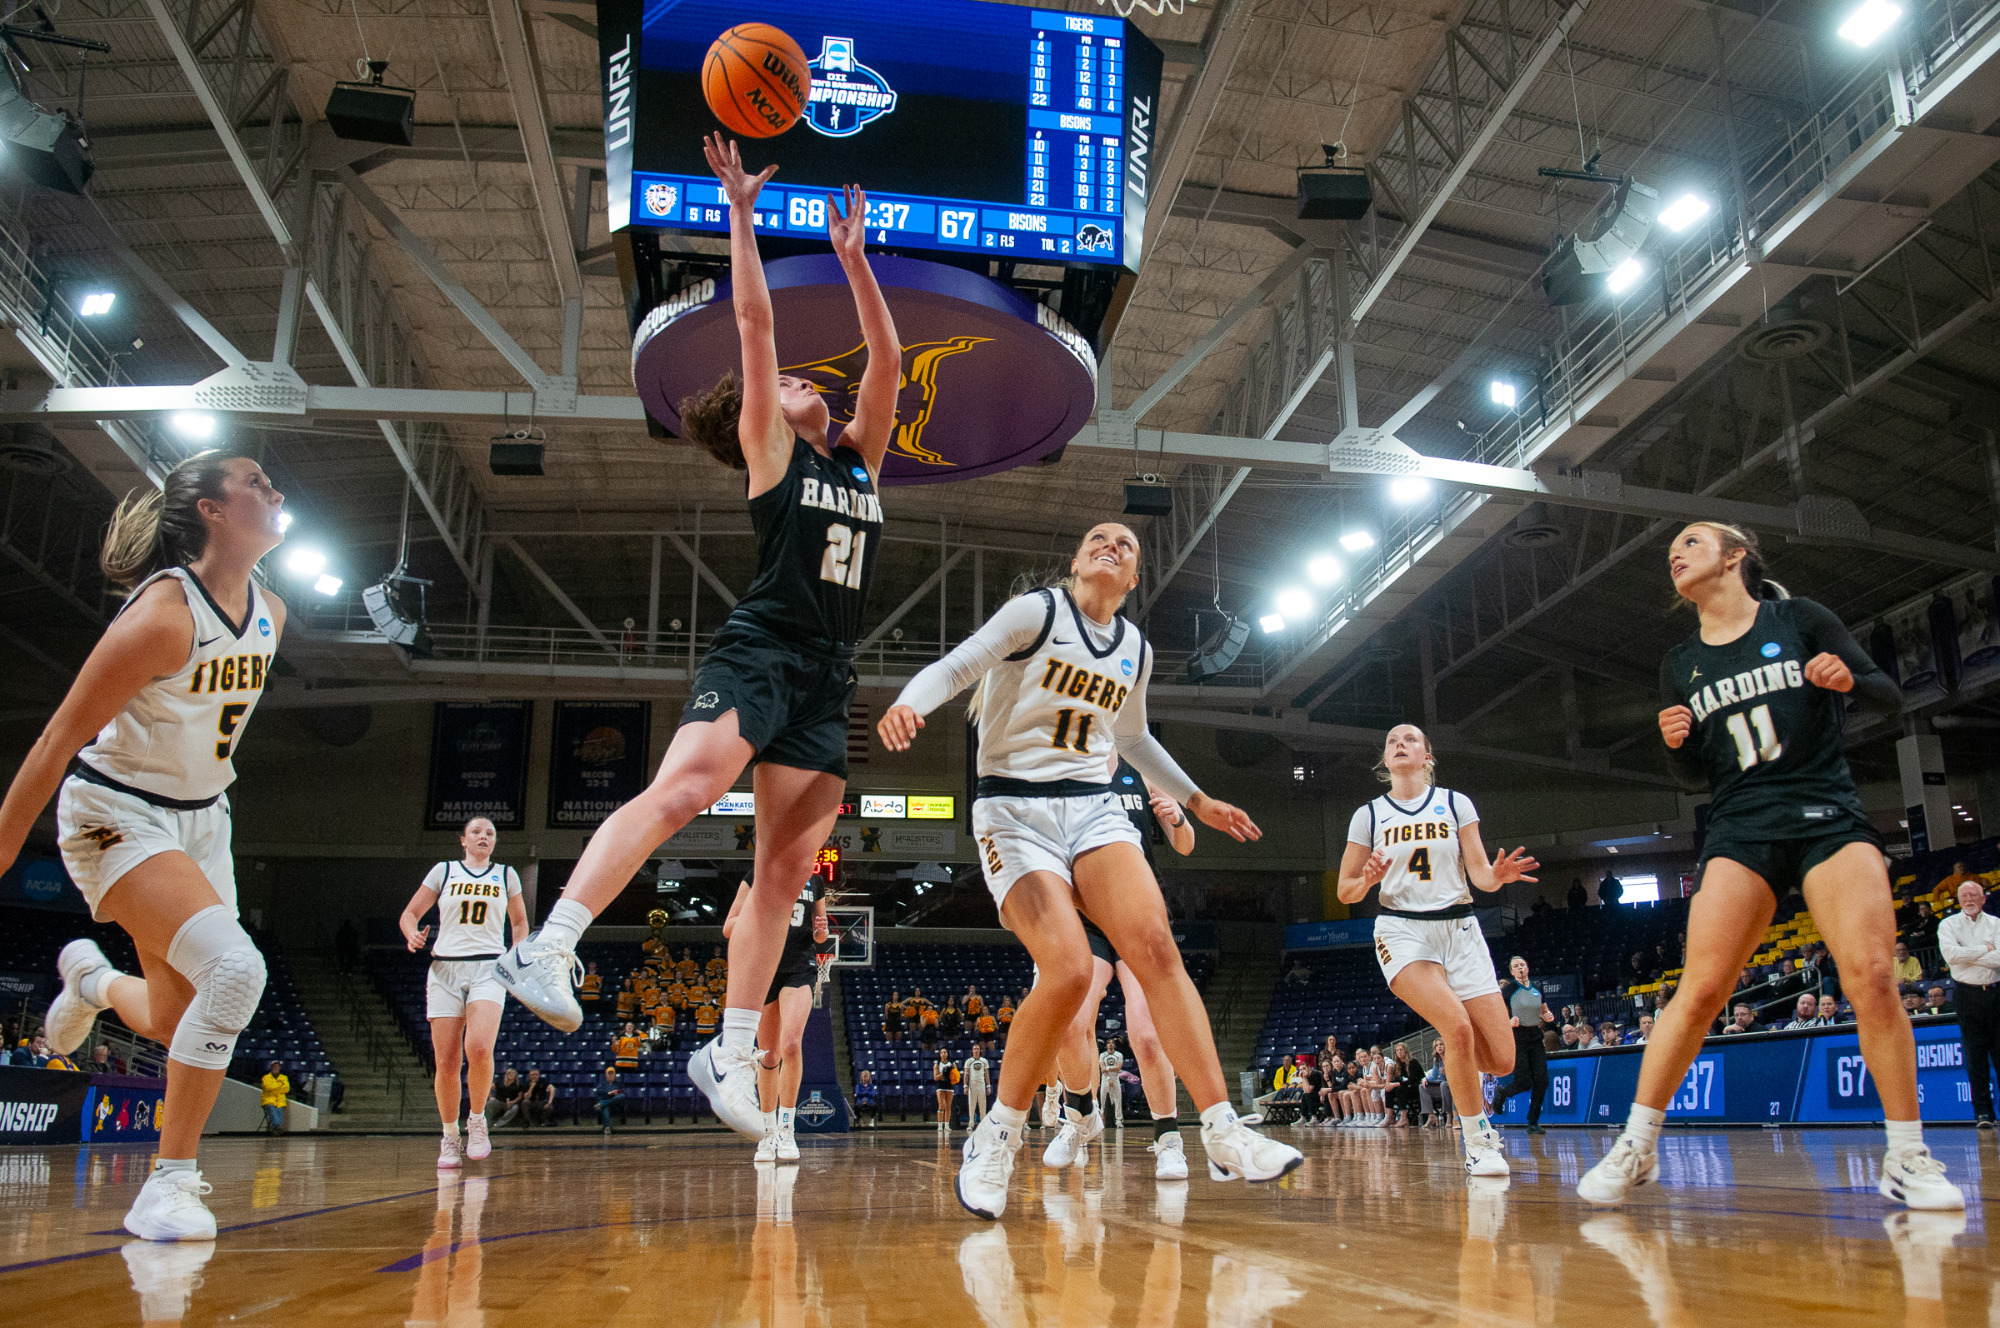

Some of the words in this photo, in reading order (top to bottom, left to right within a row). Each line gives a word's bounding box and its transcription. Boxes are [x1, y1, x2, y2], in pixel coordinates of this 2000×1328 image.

[1065, 16, 1094, 32] TIGERS
[1037, 41, 1044, 52] 4
[1082, 45, 1089, 58] 0
[1110, 48, 1115, 60] 1
[1081, 35, 1092, 45] PTS
[1104, 38, 1120, 48] FOULS
[1037, 54, 1044, 66] 5
[1082, 58, 1089, 70] 2
[1110, 61, 1114, 73] 1
[763, 50, 807, 113] Wilson
[827, 72, 847, 81] DII
[1034, 67, 1045, 79] 10
[1079, 71, 1090, 83] 12
[1108, 74, 1115, 86] 3
[608, 34, 630, 151] UNRL
[832, 81, 879, 92] BASKETBALL
[1035, 80, 1044, 92] 11
[1081, 84, 1089, 96] 6
[1109, 87, 1114, 99] 1
[808, 87, 892, 108] MPIONSHIP
[1032, 93, 1047, 106] 22
[1107, 100, 1114, 112] 4
[746, 87, 786, 129] NCAA
[1060, 114, 1092, 131] BISONS
[1033, 139, 1045, 152] 10
[1078, 144, 1089, 157] 14
[1107, 147, 1114, 159] 0
[1079, 135, 1090, 144] PTS
[1102, 137, 1119, 147] FOULS
[1128, 95, 1151, 198] UNRL
[1034, 153, 1043, 165] 11
[1080, 158, 1088, 170] 3
[1107, 160, 1114, 172] 2
[1079, 171, 1087, 183] 6
[1107, 173, 1114, 185] 3
[1032, 179, 1043, 192] 21
[1078, 184, 1089, 197] 19
[1106, 186, 1114, 199] 3
[1030, 193, 1045, 206] 23
[1080, 197, 1087, 210] 8
[1106, 200, 1114, 212] 2
[689, 207, 698, 221] 5
[705, 209, 721, 223] FLS
[752, 213, 764, 226] OL
[769, 214, 778, 228] 4
[789, 197, 825, 228] 68
[941, 210, 975, 239] 67
[1009, 212, 1047, 232] BISONS
[877, 230, 886, 244] 4
[986, 233, 994, 247] 2
[1000, 234, 1015, 248] FLS
[1041, 237, 1055, 251] TOL
[1061, 240, 1069, 253] 2
[819, 522, 866, 590] 21
[1040, 656, 1128, 713] TIGERS
[1689, 660, 1804, 723] HARDING
[214, 701, 250, 762] 5
[1051, 708, 1096, 754] 11
[1726, 704, 1782, 772] 11
[461, 771, 497, 779] RECORD
[581, 771, 616, 779] RECORD
[443, 801, 509, 811] NATIONAL
[563, 801, 625, 811] NATIONA
[863, 800, 903, 813] Abdo
[1121, 794, 1143, 810] NG
[556, 811, 606, 822] CHAMPI
[1384, 822, 1449, 847] TIGERS
[1408, 846, 1433, 882] 4
[25, 879, 62, 893] NCAA
[450, 883, 500, 898] TIGERS
[459, 900, 488, 925] 10
[0, 983, 35, 993] NSHIP
[1917, 1043, 1963, 1068] BISONS
[1553, 1076, 1571, 1107] 68
[1837, 1056, 1867, 1097] 67
[0, 1101, 59, 1132] NSHIP
[1599, 1104, 1610, 1116] 4TH
[1770, 1102, 1780, 1116] 27
